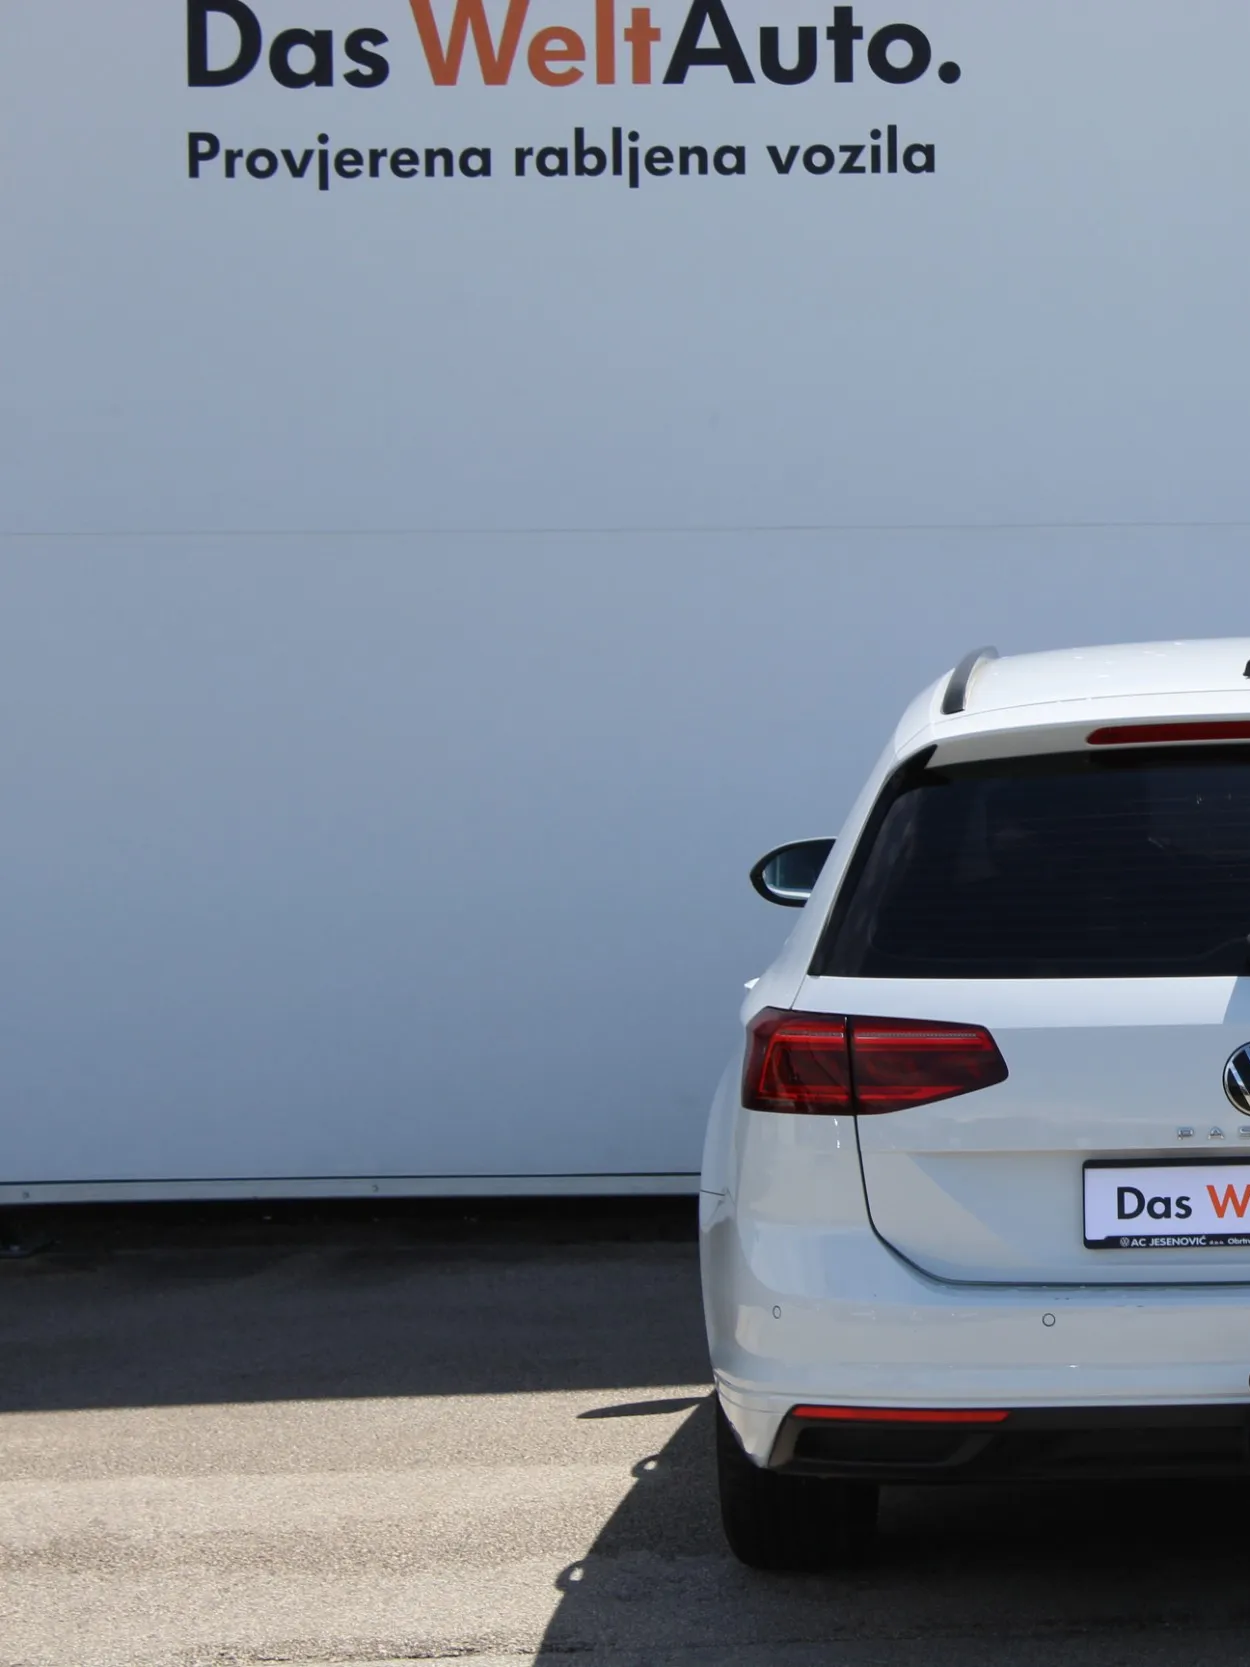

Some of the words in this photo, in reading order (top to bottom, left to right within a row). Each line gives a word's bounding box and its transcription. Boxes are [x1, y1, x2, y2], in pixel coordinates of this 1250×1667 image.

[187, 0, 389, 88] Das
[413, 0, 962, 87] WeltAuto.
[187, 131, 492, 191] Provjerena
[515, 127, 747, 188] rabljena
[766, 125, 937, 175] vozila
[1116, 1186, 1193, 1220] Das
[1130, 1238, 1147, 1247] AC
[1149, 1234, 1207, 1246] JESENOVIĆ
